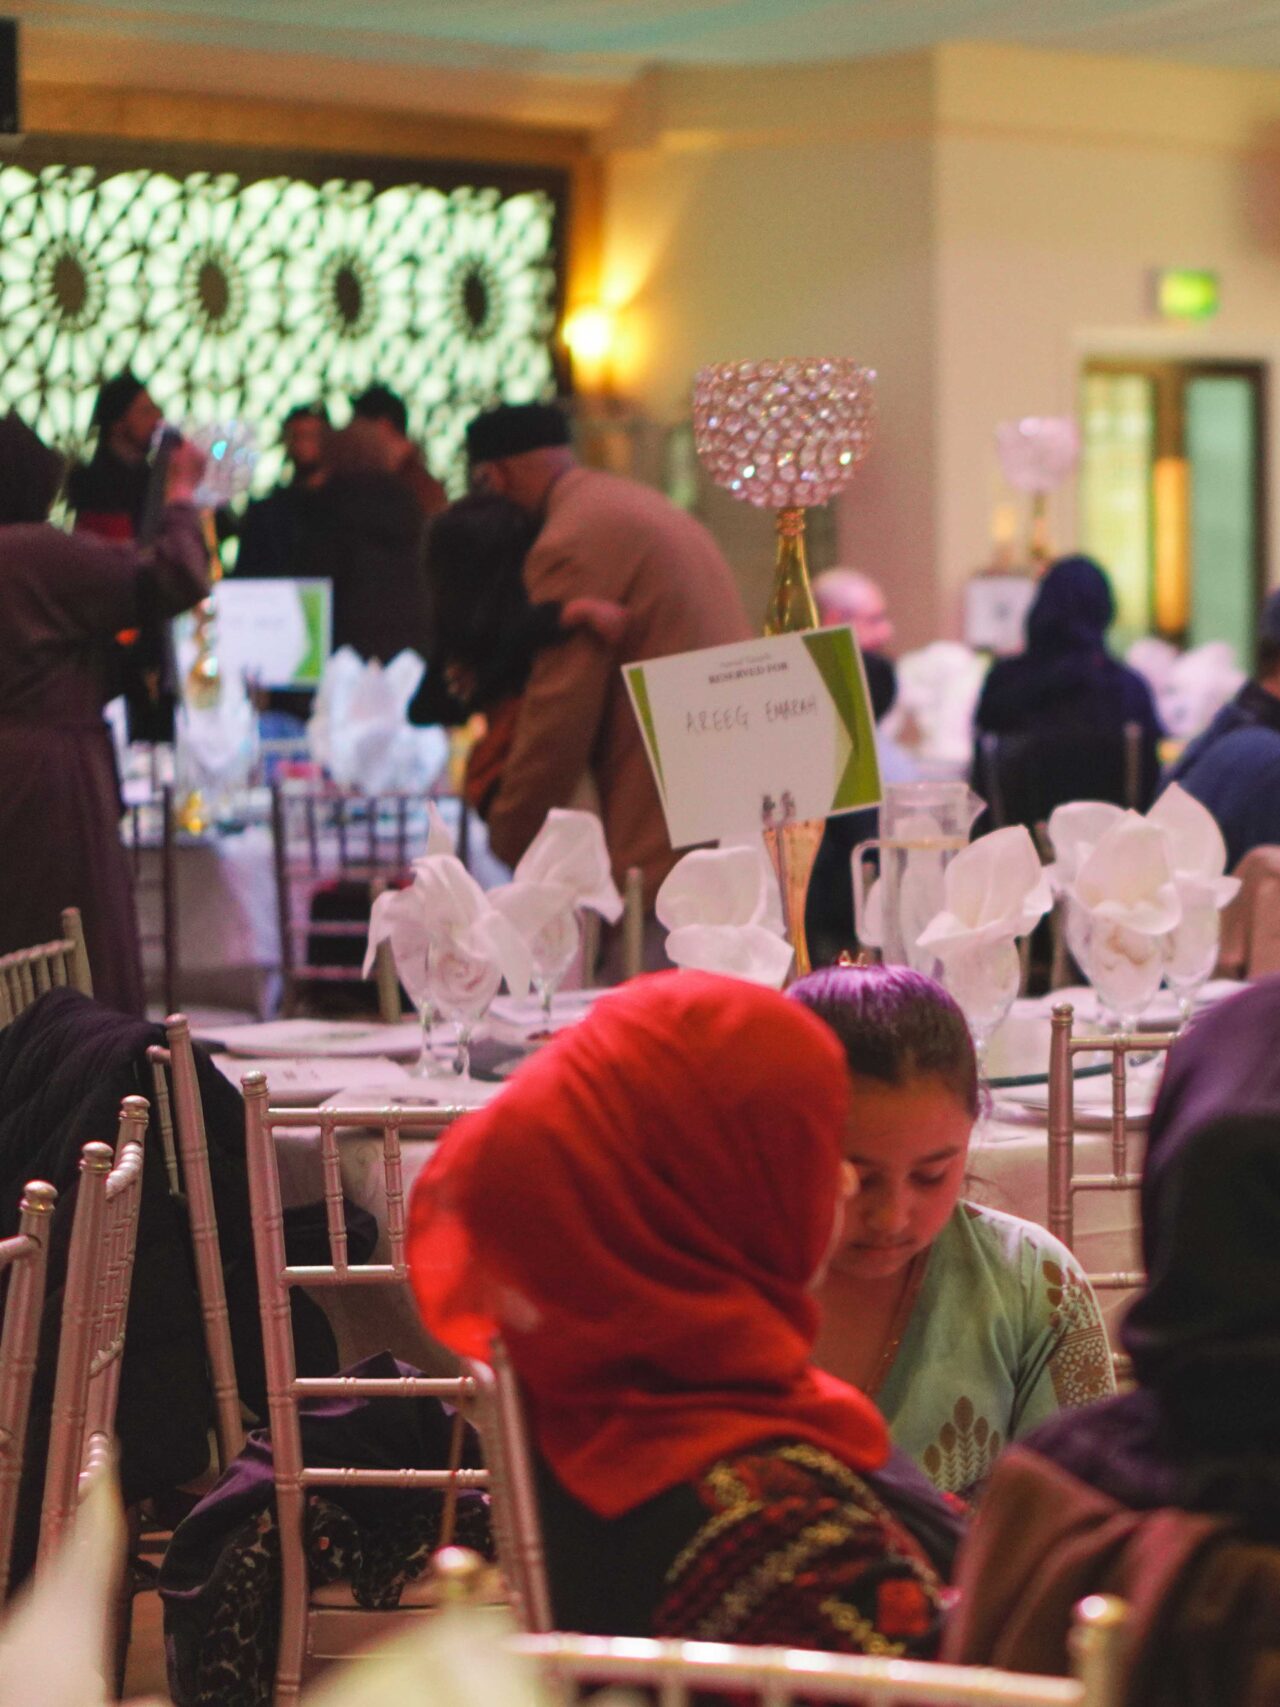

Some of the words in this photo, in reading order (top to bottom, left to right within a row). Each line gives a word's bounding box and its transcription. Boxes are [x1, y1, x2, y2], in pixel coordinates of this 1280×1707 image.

[708, 664, 765, 684] RESERVED
[766, 661, 788, 674] FOR
[686, 704, 749, 735] AREEG
